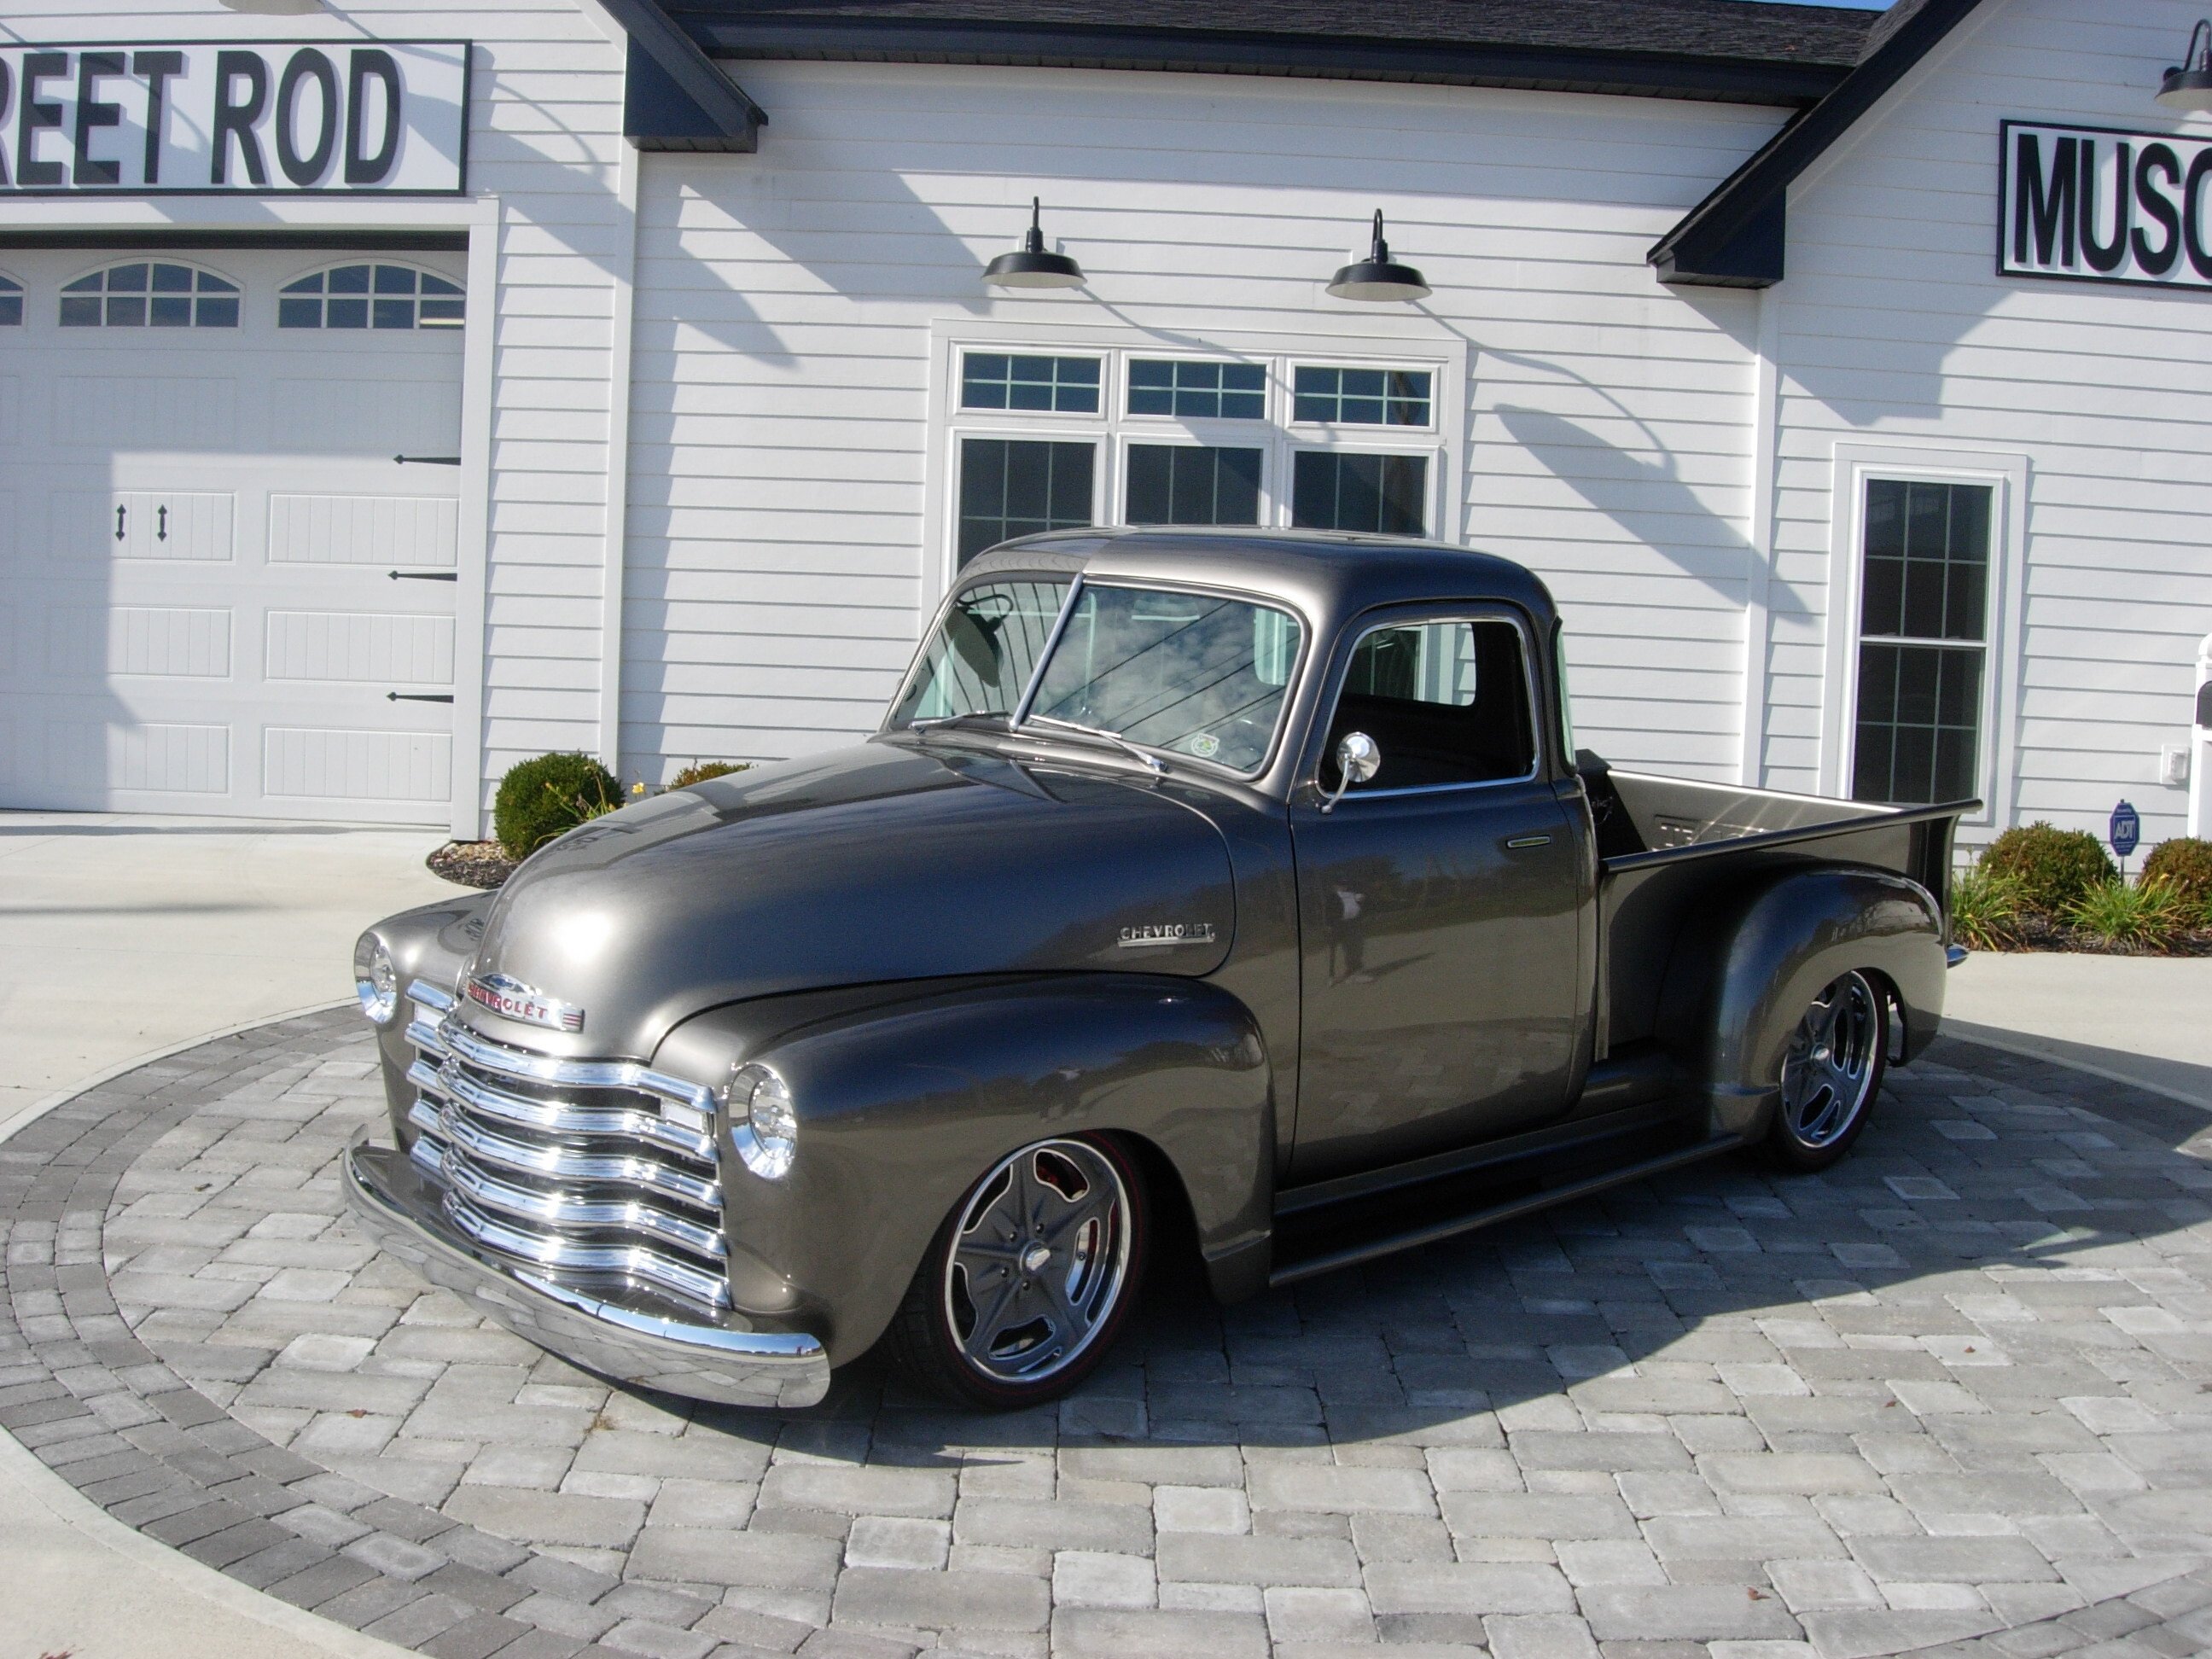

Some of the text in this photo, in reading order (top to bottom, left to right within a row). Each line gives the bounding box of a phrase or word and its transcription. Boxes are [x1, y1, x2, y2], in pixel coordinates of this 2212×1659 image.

[0, 47, 401, 186] EET ROD
[2114, 821, 2135, 840] ADT
[1120, 923, 1213, 940] CHEVROLET
